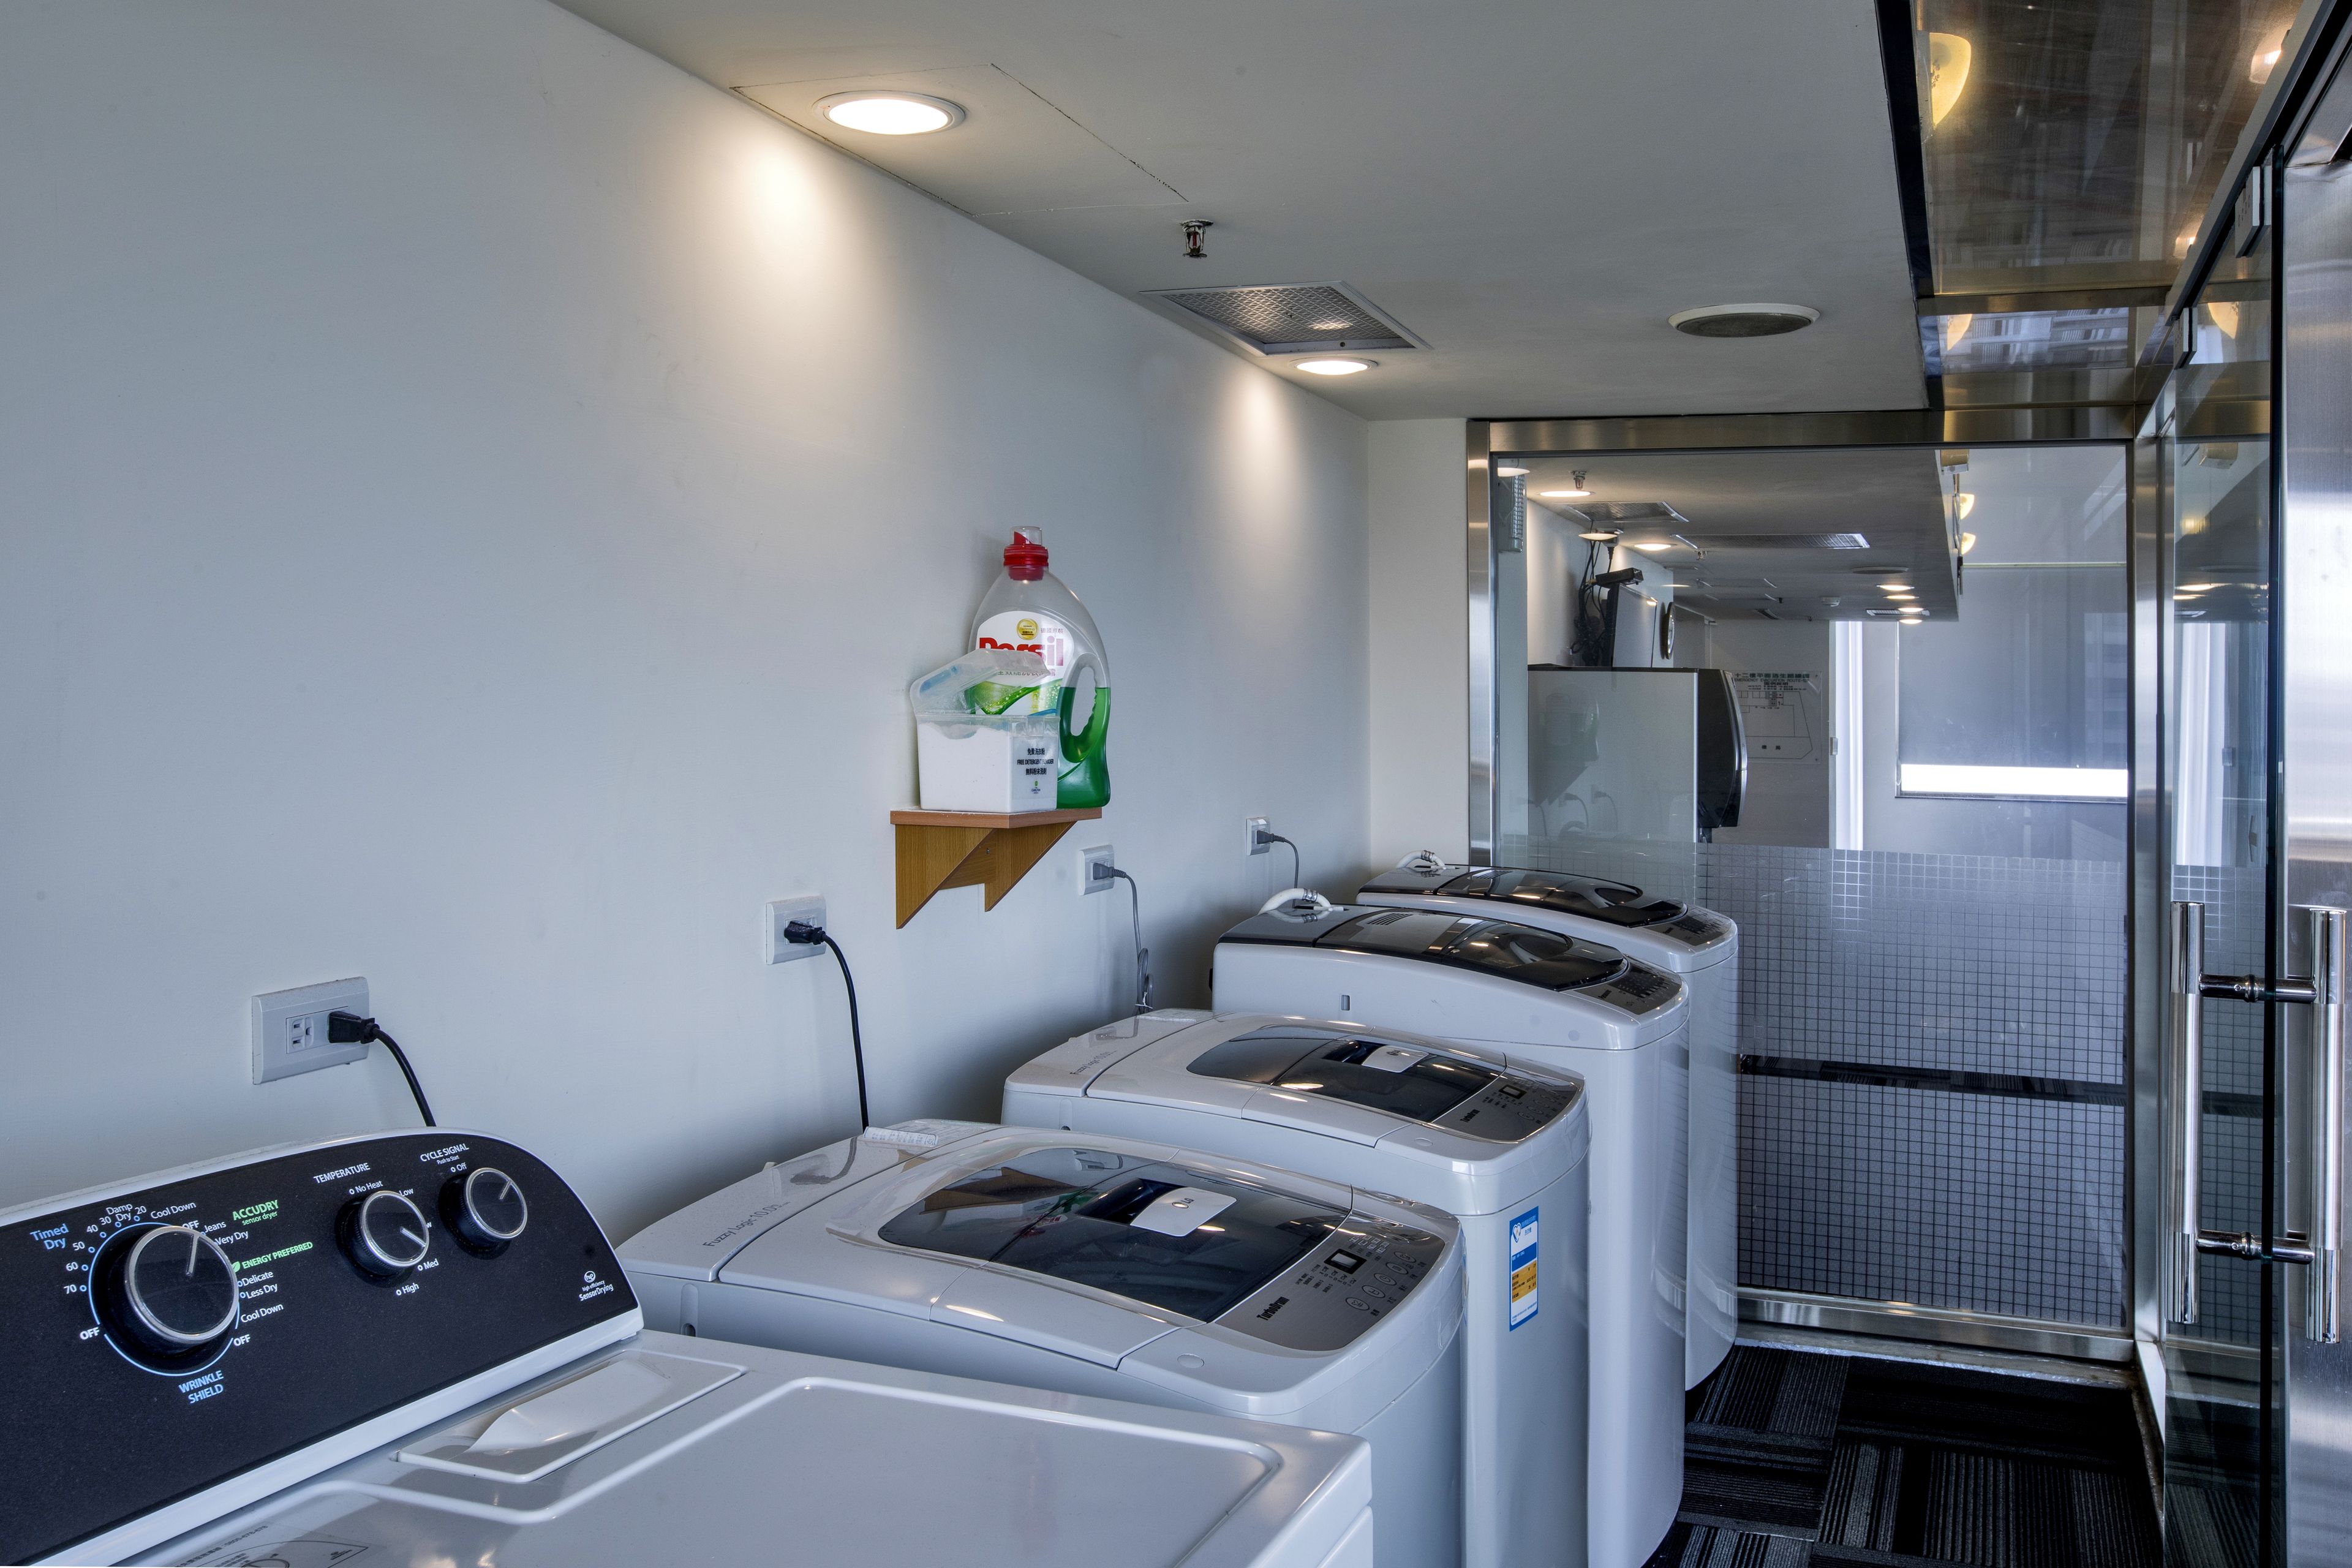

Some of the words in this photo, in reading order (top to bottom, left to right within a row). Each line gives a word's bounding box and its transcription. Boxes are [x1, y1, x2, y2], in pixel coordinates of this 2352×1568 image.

[420, 1150, 444, 1162] CYCLE
[442, 1143, 469, 1156] SIGNAL
[313, 1163, 371, 1183] TEMPERATURE
[456, 1163, 467, 1171] Off
[355, 1185, 367, 1194] No
[366, 1180, 383, 1191] Heat
[399, 1188, 414, 1197] Low
[106, 1204, 133, 1215] Damp
[135, 1205, 147, 1215] 20
[150, 1209, 171, 1219] Cool
[170, 1202, 197, 1215] Down
[232, 1199, 279, 1221] ACCUDRY
[99, 1216, 111, 1225] 30
[115, 1212, 132, 1222] Dry
[242, 1215, 262, 1226] sensor
[262, 1211, 277, 1222] dryer
[86, 1224, 99, 1233] 40
[182, 1220, 199, 1229] OFF
[203, 1221, 227, 1234] Jeans
[29, 1223, 69, 1241] Timed
[215, 1234, 234, 1246] Very
[234, 1230, 249, 1241] Dry
[703, 1230, 736, 1246] Fuzzy
[728, 1219, 757, 1231] Logic
[44, 1238, 66, 1250] Dry
[72, 1241, 85, 1251] 50
[242, 1253, 273, 1269] ENERGY
[273, 1242, 314, 1260] PREFERRED
[66, 1262, 78, 1272] 60
[423, 1258, 439, 1270] Med
[241, 1271, 274, 1286] Delicate
[590, 1280, 605, 1289] efficiency
[63, 1284, 77, 1294] 70
[246, 1288, 264, 1299] Less
[263, 1283, 278, 1294] Dry
[402, 1282, 420, 1294] High
[579, 1284, 614, 1302] SensorDrying
[241, 1310, 260, 1323] Cool
[260, 1304, 284, 1317] Down
[1257, 1297, 1289, 1321] TurboDrum
[80, 1327, 100, 1340] OFF
[233, 1334, 251, 1346] OFF
[178, 1370, 224, 1393] WRINKLE
[188, 1384, 224, 1404] SHIELD
